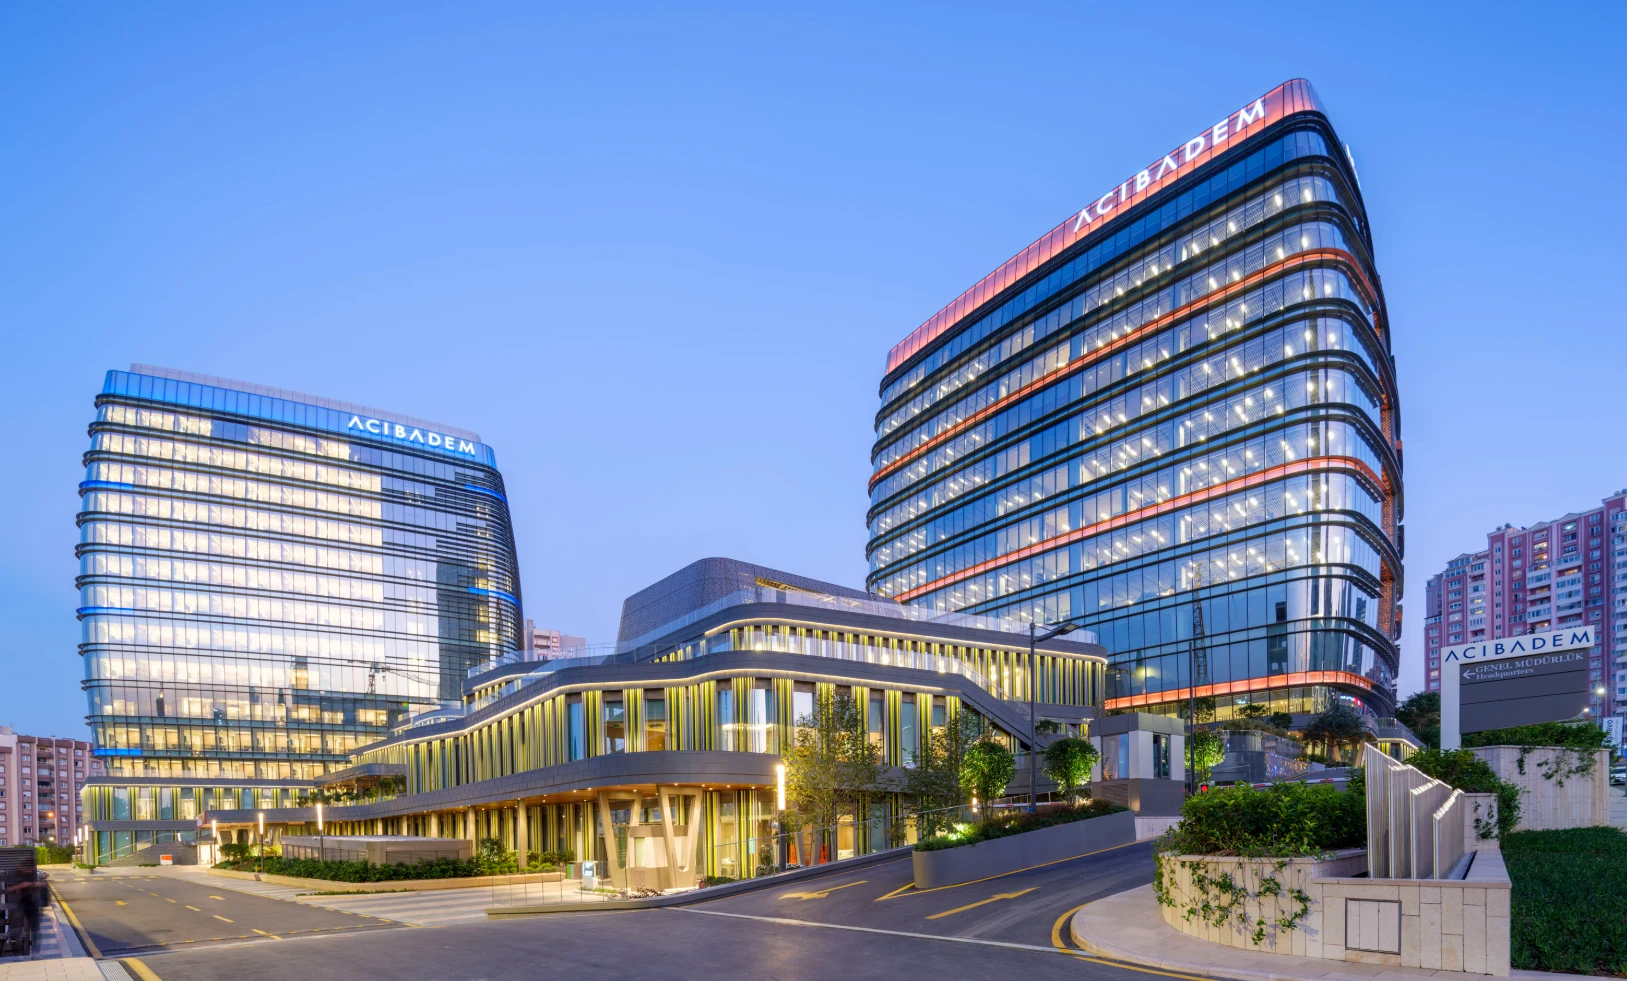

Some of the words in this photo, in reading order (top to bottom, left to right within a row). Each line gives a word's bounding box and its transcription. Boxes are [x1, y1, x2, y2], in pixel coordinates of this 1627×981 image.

[1073, 98, 1266, 233] ACIBADEM
[348, 415, 476, 455] ACIBADEM
[1445, 630, 1590, 662] ACIBADEM
[1475, 662, 1513, 673] GENEL
[1515, 652, 1584, 669] MÜDÜRLÜK
[1476, 667, 1534, 681] Headquarters
